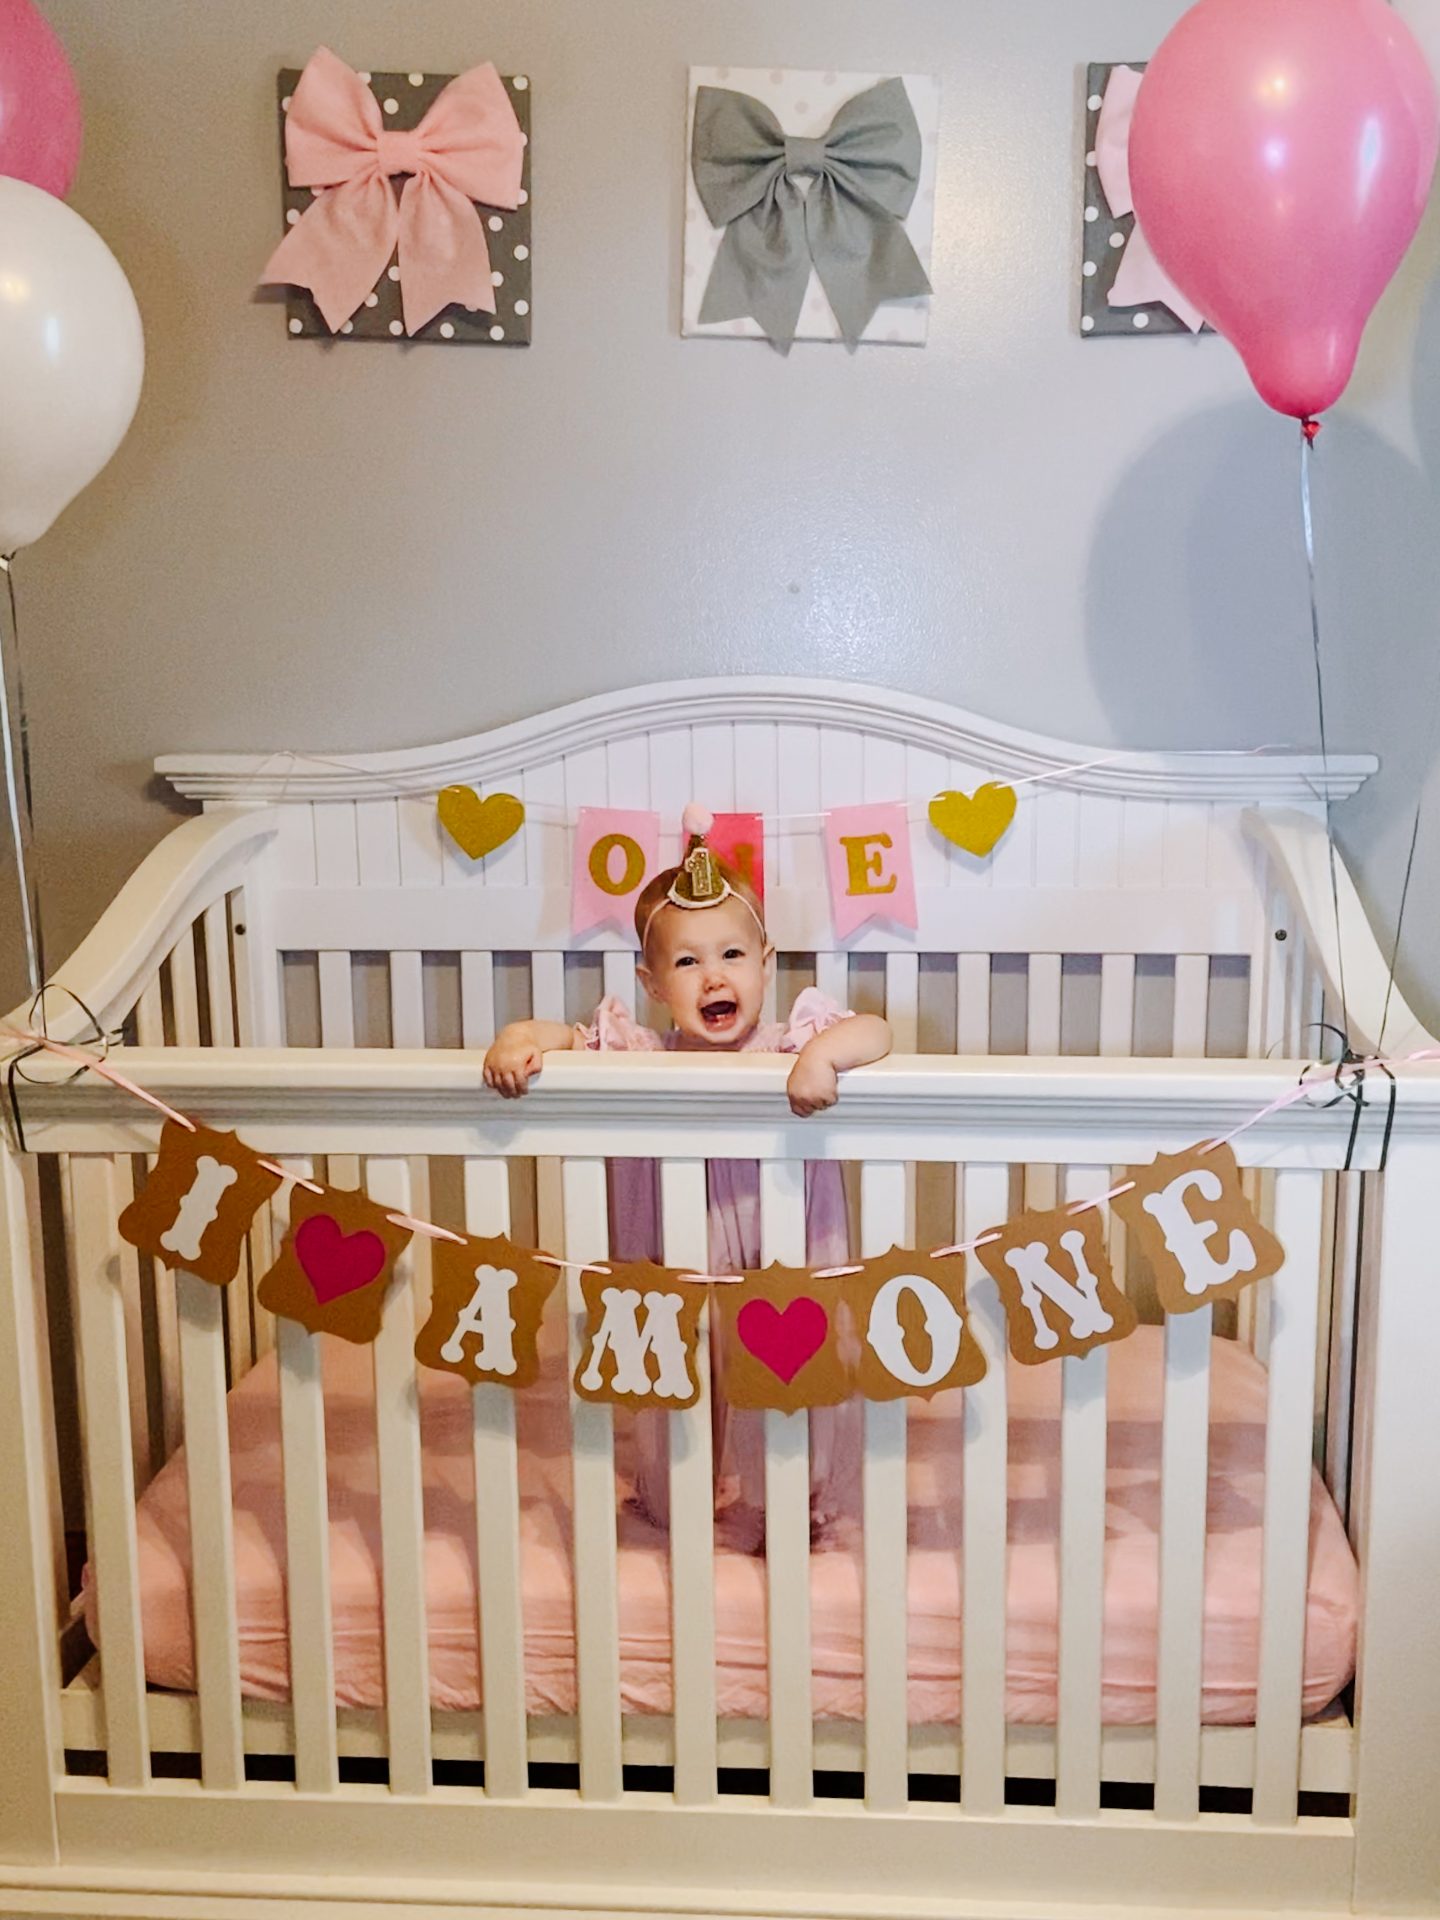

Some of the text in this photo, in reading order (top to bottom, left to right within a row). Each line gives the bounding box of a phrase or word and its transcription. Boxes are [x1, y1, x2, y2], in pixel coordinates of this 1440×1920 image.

[684, 847, 713, 897] 1
[160, 1154, 1256, 1400] I AM ONE
